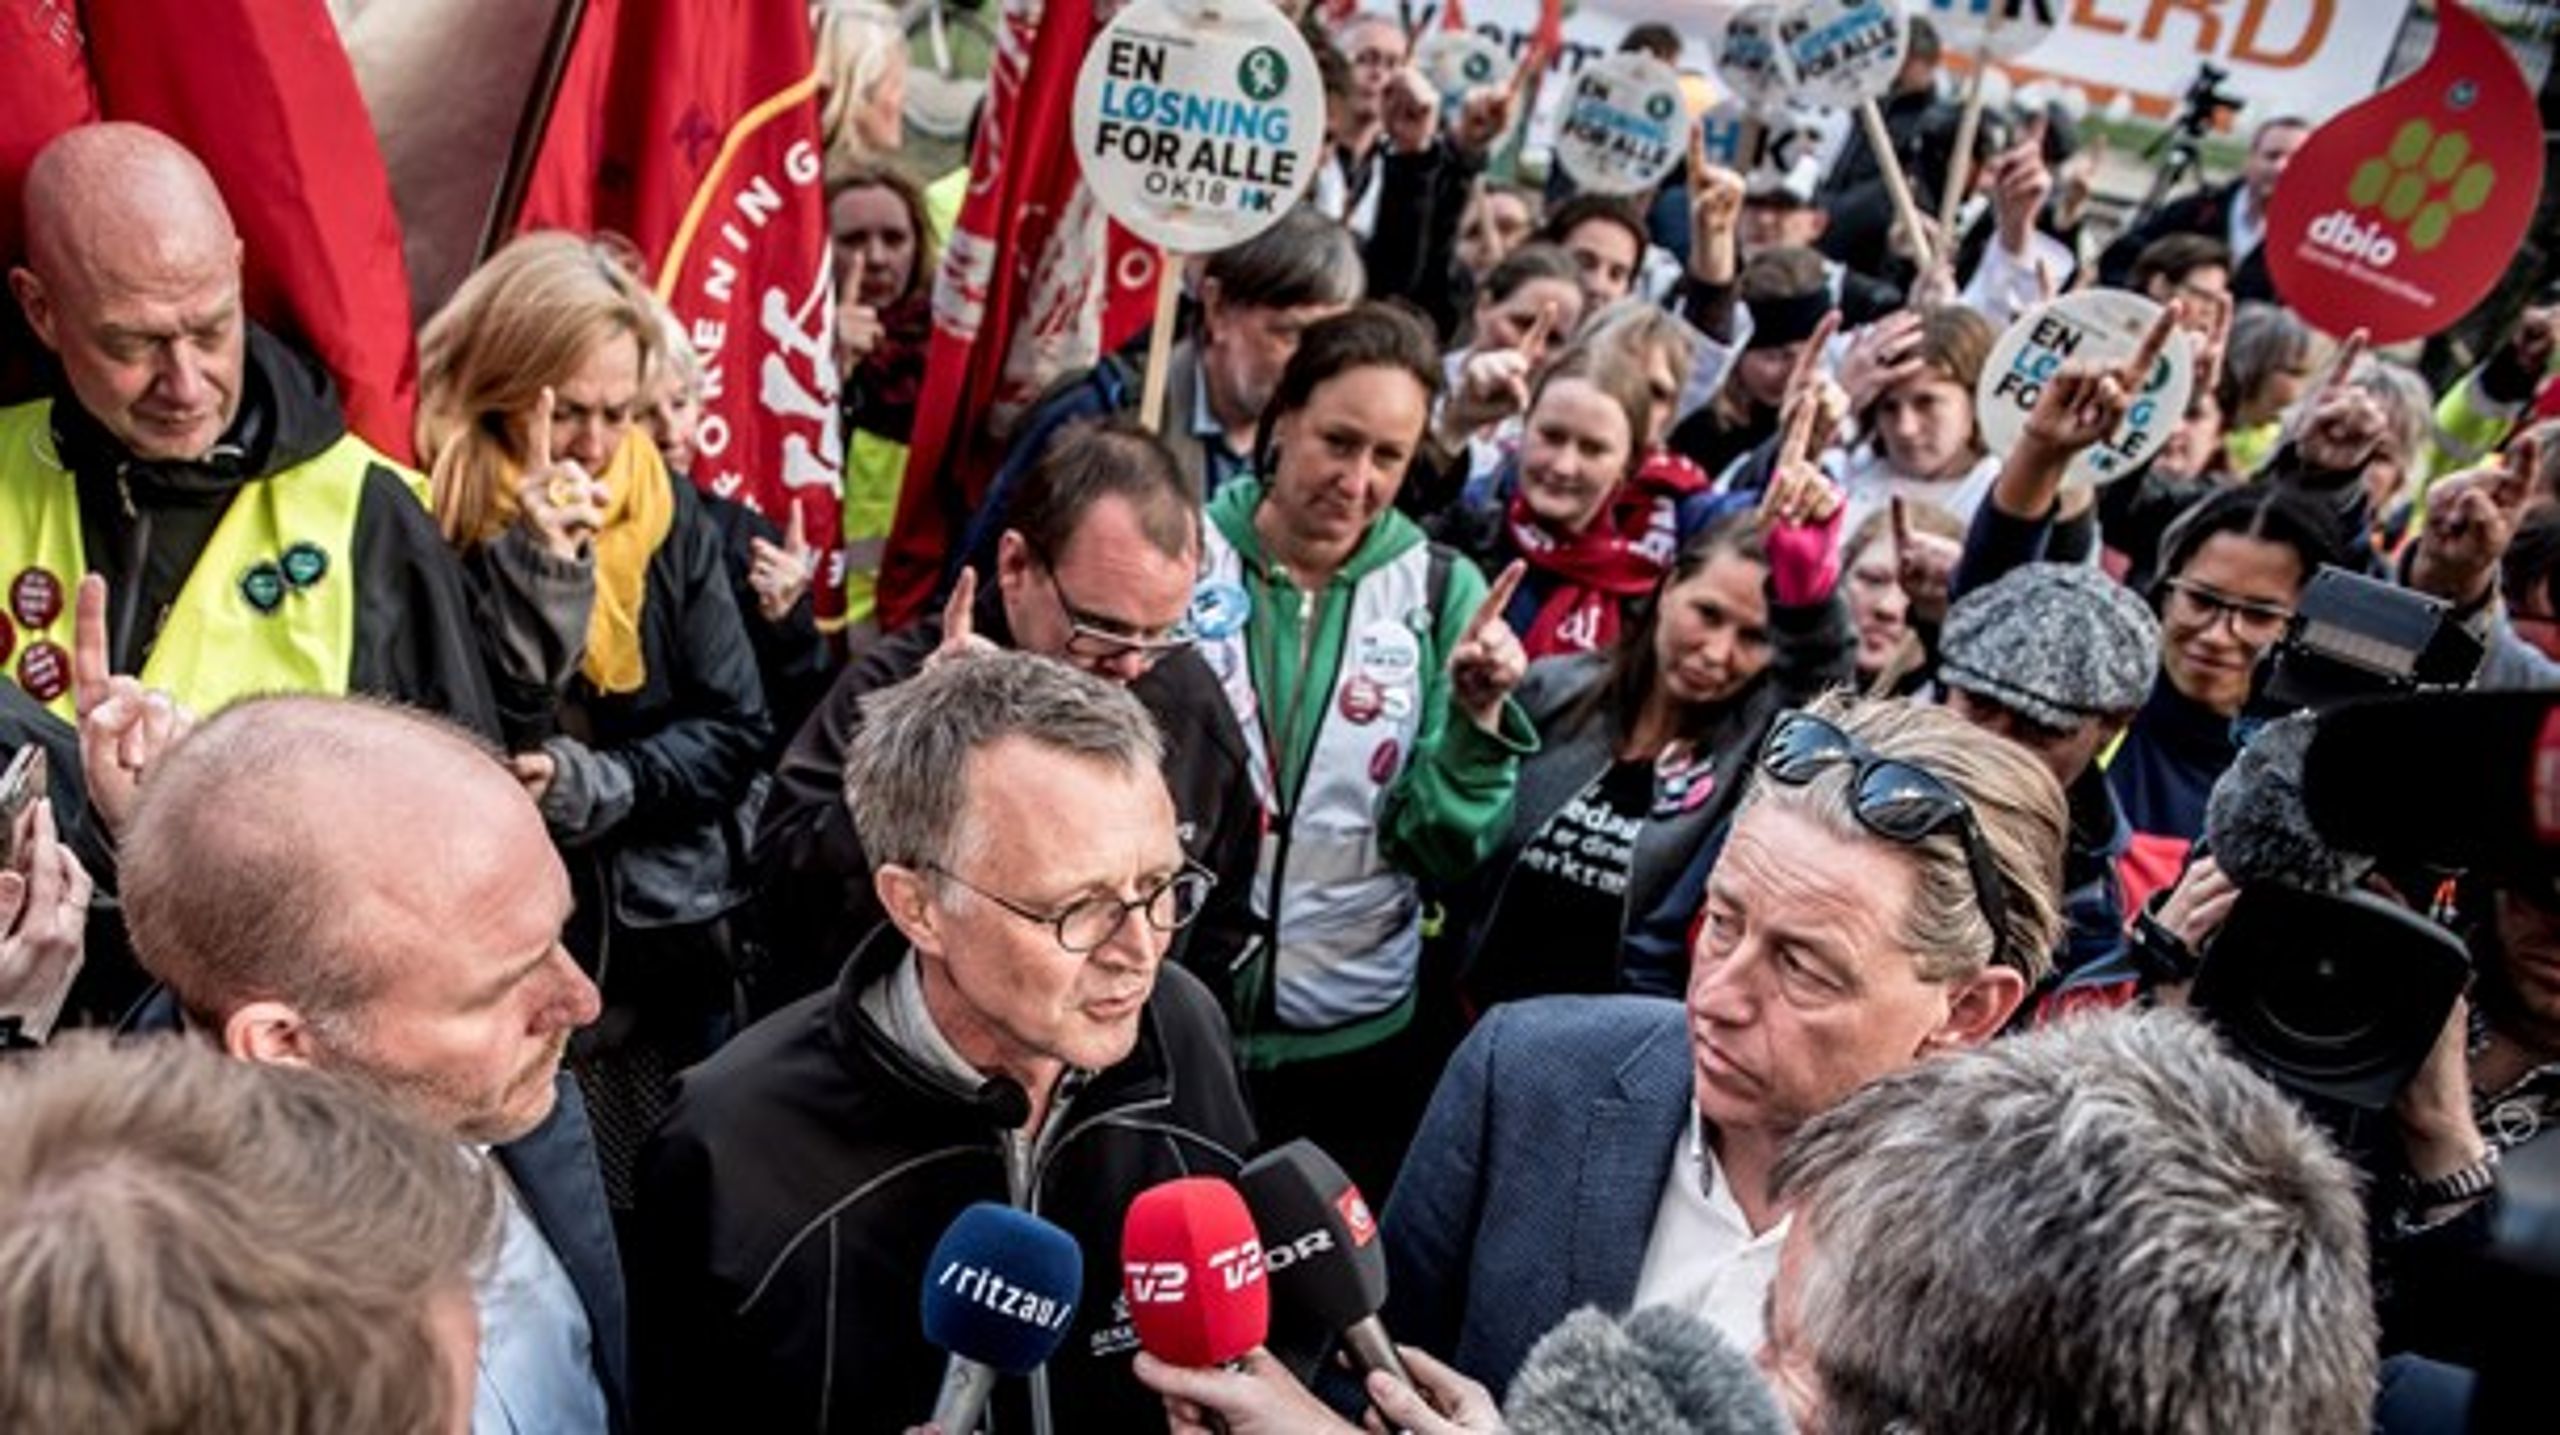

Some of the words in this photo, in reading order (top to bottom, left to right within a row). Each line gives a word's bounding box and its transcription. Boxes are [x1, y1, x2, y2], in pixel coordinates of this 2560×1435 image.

[1107, 41, 1166, 83] EN
[1101, 80, 1291, 146] LØSNING
[1095, 121, 1182, 170] FOR
[1187, 138, 1298, 188] ALLE
[1144, 170, 1228, 206] OK18
[2306, 208, 2397, 268] dbio
[2030, 316, 2083, 358] EN
[1993, 372, 2044, 412] FO
[1208, 1240, 1263, 1291] TV2
[1266, 1227, 1336, 1272] DR
[1124, 1262, 1190, 1303] TV2
